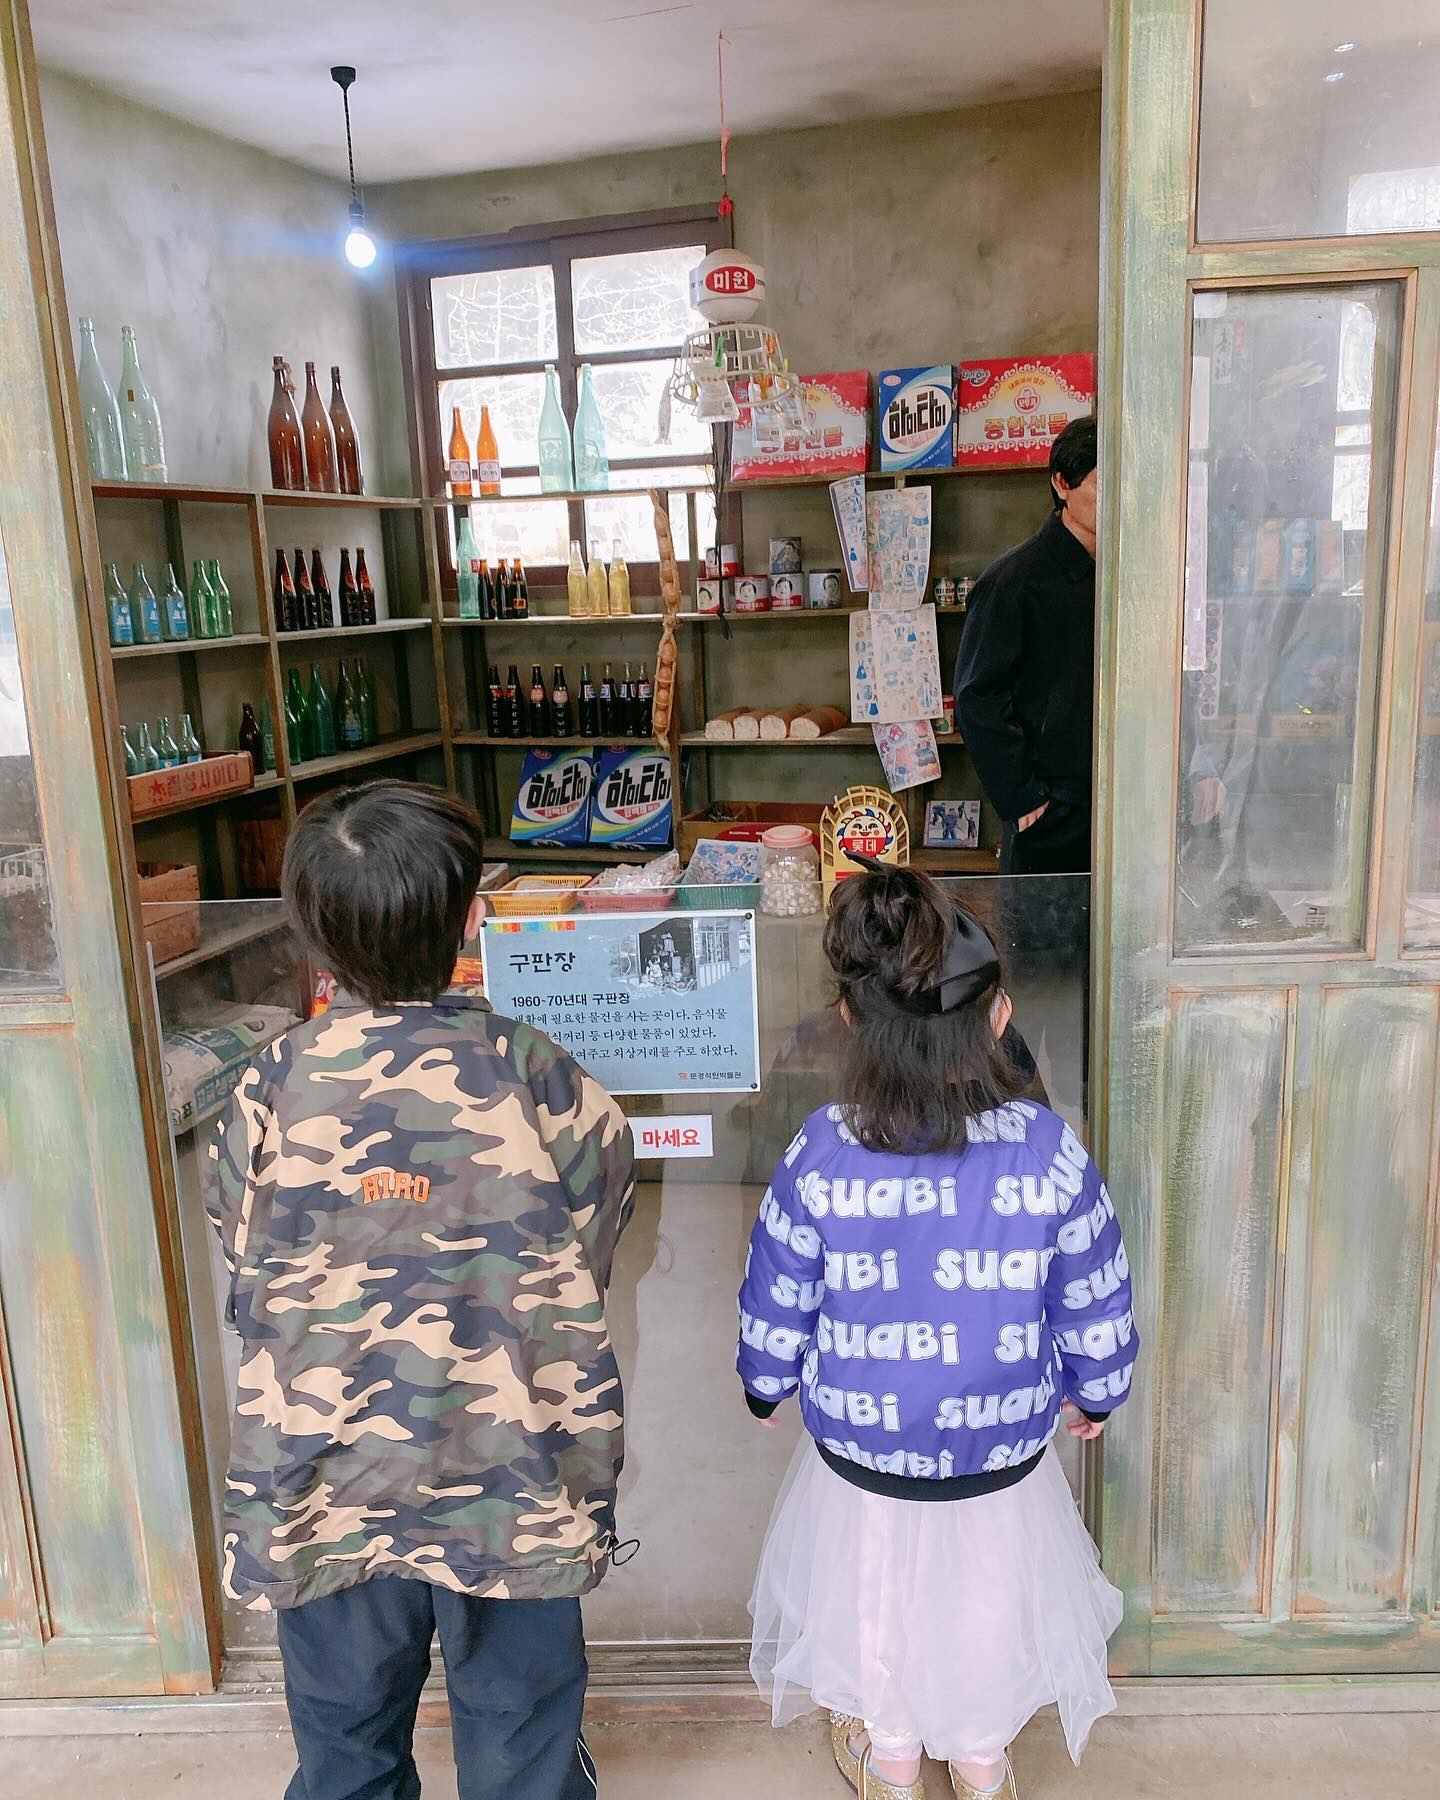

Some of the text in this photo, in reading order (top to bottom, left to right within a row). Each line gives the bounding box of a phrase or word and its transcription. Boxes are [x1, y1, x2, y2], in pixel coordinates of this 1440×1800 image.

[713, 270, 749, 290] 미원
[888, 390, 947, 440] 하이타이
[984, 413, 1068, 440] 종합선물
[526, 763, 587, 809] 하이타이
[606, 762, 671, 809] 하이타이
[852, 838, 877, 853] 롯데
[509, 952, 576, 974] 구판장
[592, 992, 631, 1006] 구판장
[551, 1011, 586, 1025] 필요한
[589, 1010, 624, 1024] 물건을
[627, 1009, 650, 1022] 사는
[652, 1009, 690, 1021] 곳이다.
[693, 1007, 728, 1020] 음식물
[546, 1026, 717, 1043] 식거리 등 다양한 물품이 있었다.
[568, 1044, 739, 1061] 여주고 외상거래를 주로 하였다.
[642, 1127, 700, 1150] 마세요
